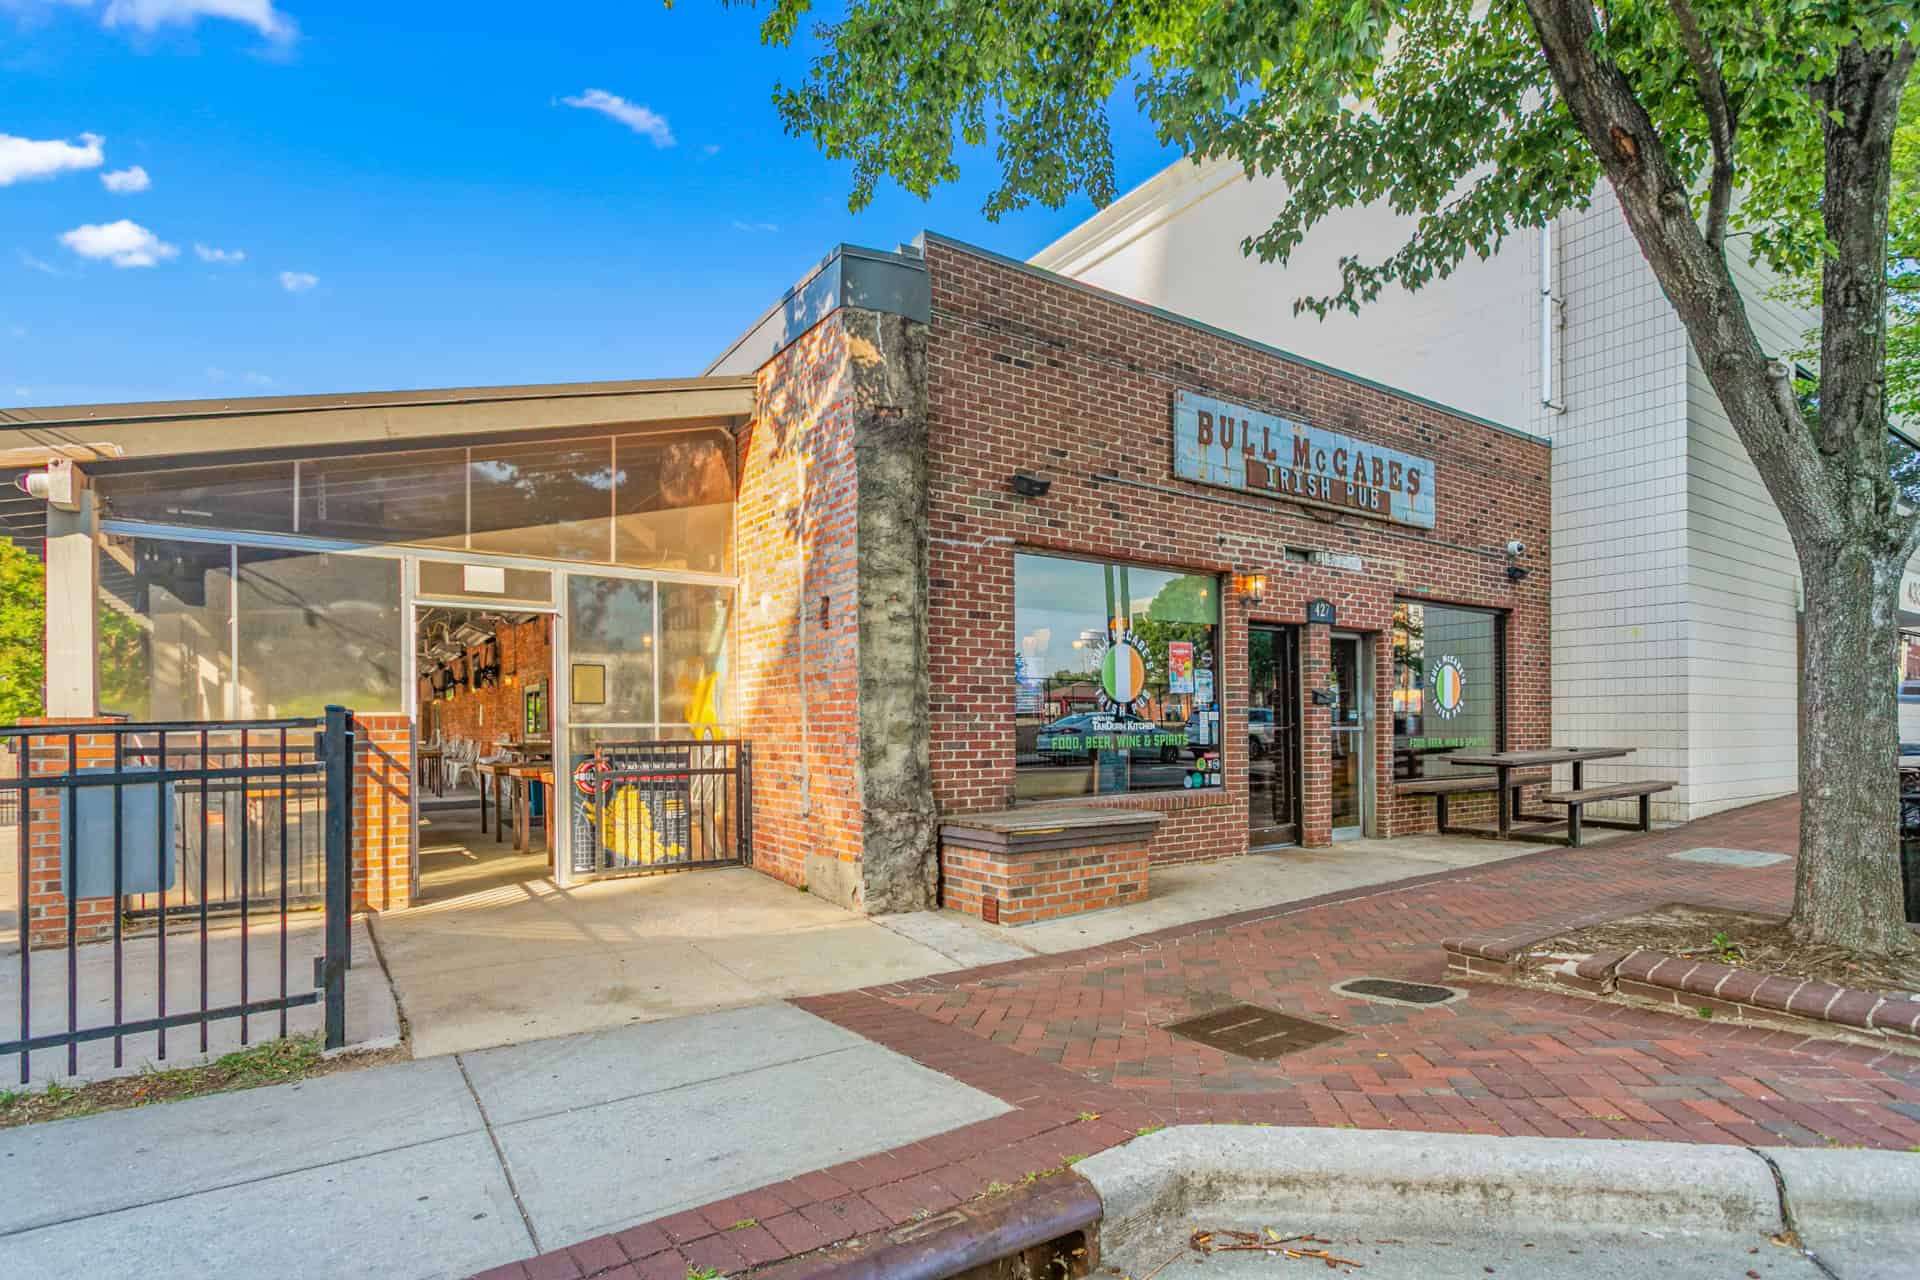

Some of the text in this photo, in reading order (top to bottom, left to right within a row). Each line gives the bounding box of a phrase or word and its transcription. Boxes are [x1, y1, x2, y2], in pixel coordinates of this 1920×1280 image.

[1198, 411, 1277, 461] BULL
[1266, 463, 1379, 509] IRISH PUB
[1314, 602, 1330, 617] 427
[1095, 688, 1151, 717] IRISH PUB
[1116, 735, 1141, 748] WINE
[1154, 733, 1189, 746] SPIRITS
